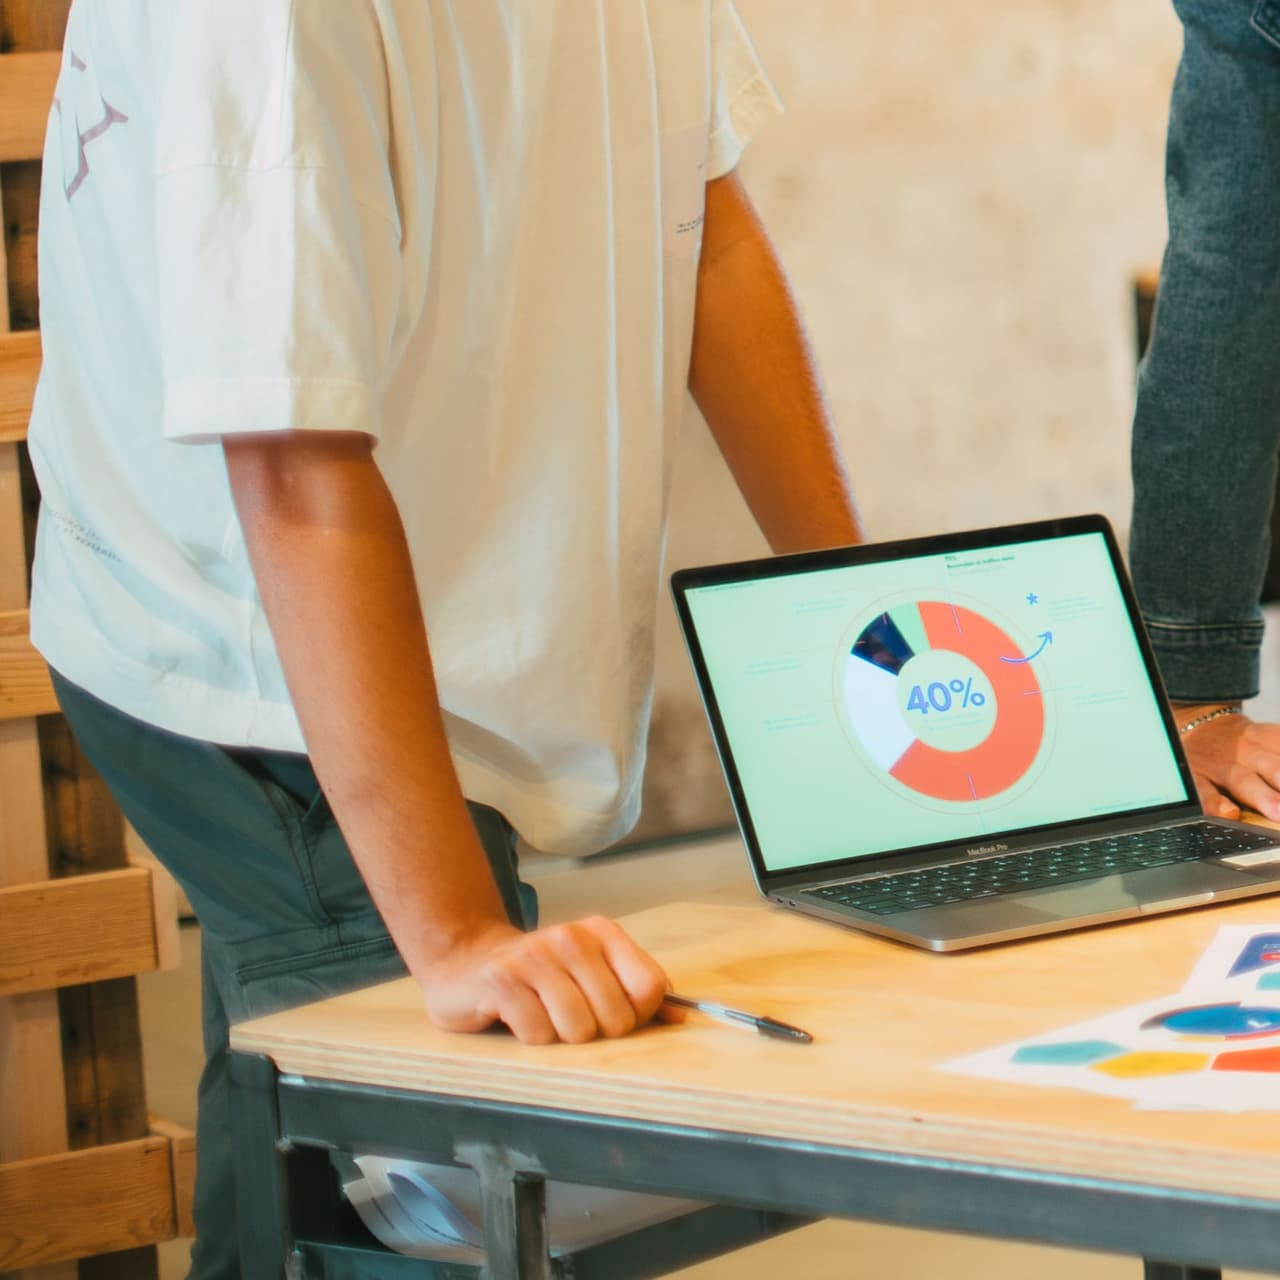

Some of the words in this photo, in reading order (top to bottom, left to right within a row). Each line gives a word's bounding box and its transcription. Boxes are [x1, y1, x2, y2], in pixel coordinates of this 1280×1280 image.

[906, 677, 986, 714] 40%
[966, 846, 995, 857] MacBook
[996, 843, 1009, 852] Pro
